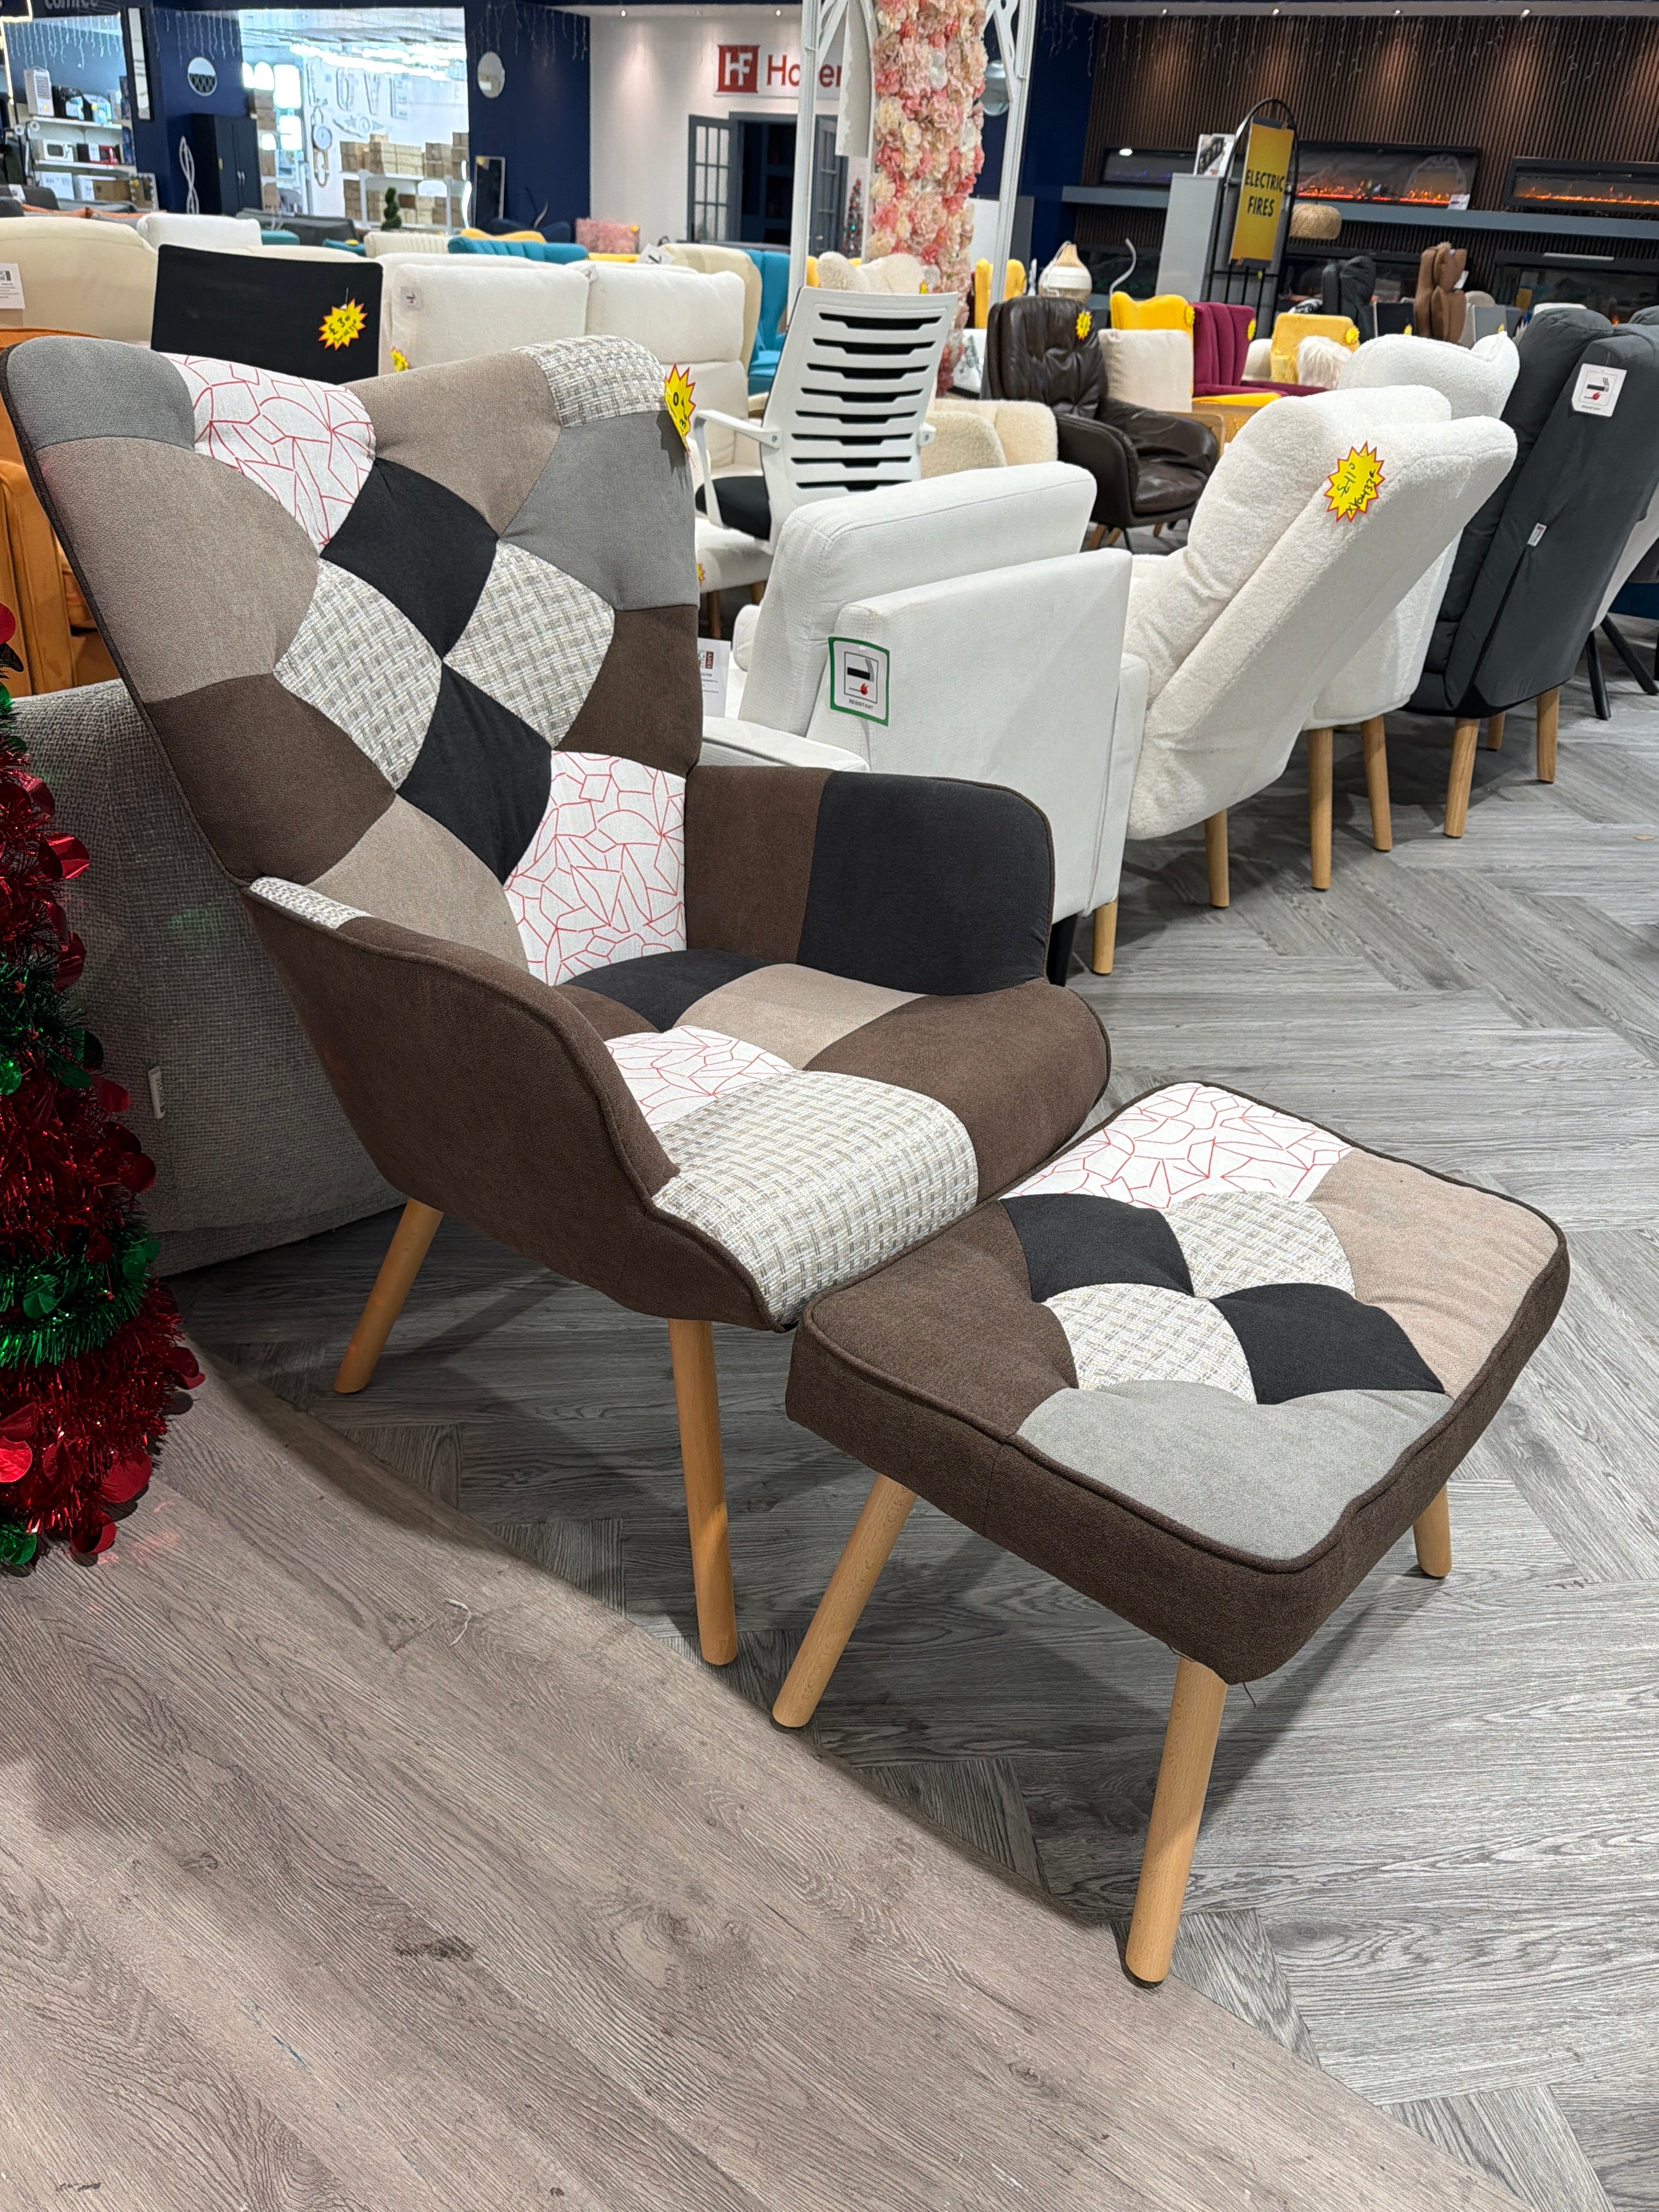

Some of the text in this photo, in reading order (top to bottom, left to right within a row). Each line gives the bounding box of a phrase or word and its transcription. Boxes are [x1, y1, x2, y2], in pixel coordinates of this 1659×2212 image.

[1245, 169, 1285, 193] ELECTRIC
[1247, 195, 1275, 217] FIRES
[849, 698, 873, 710] RESISTANT
